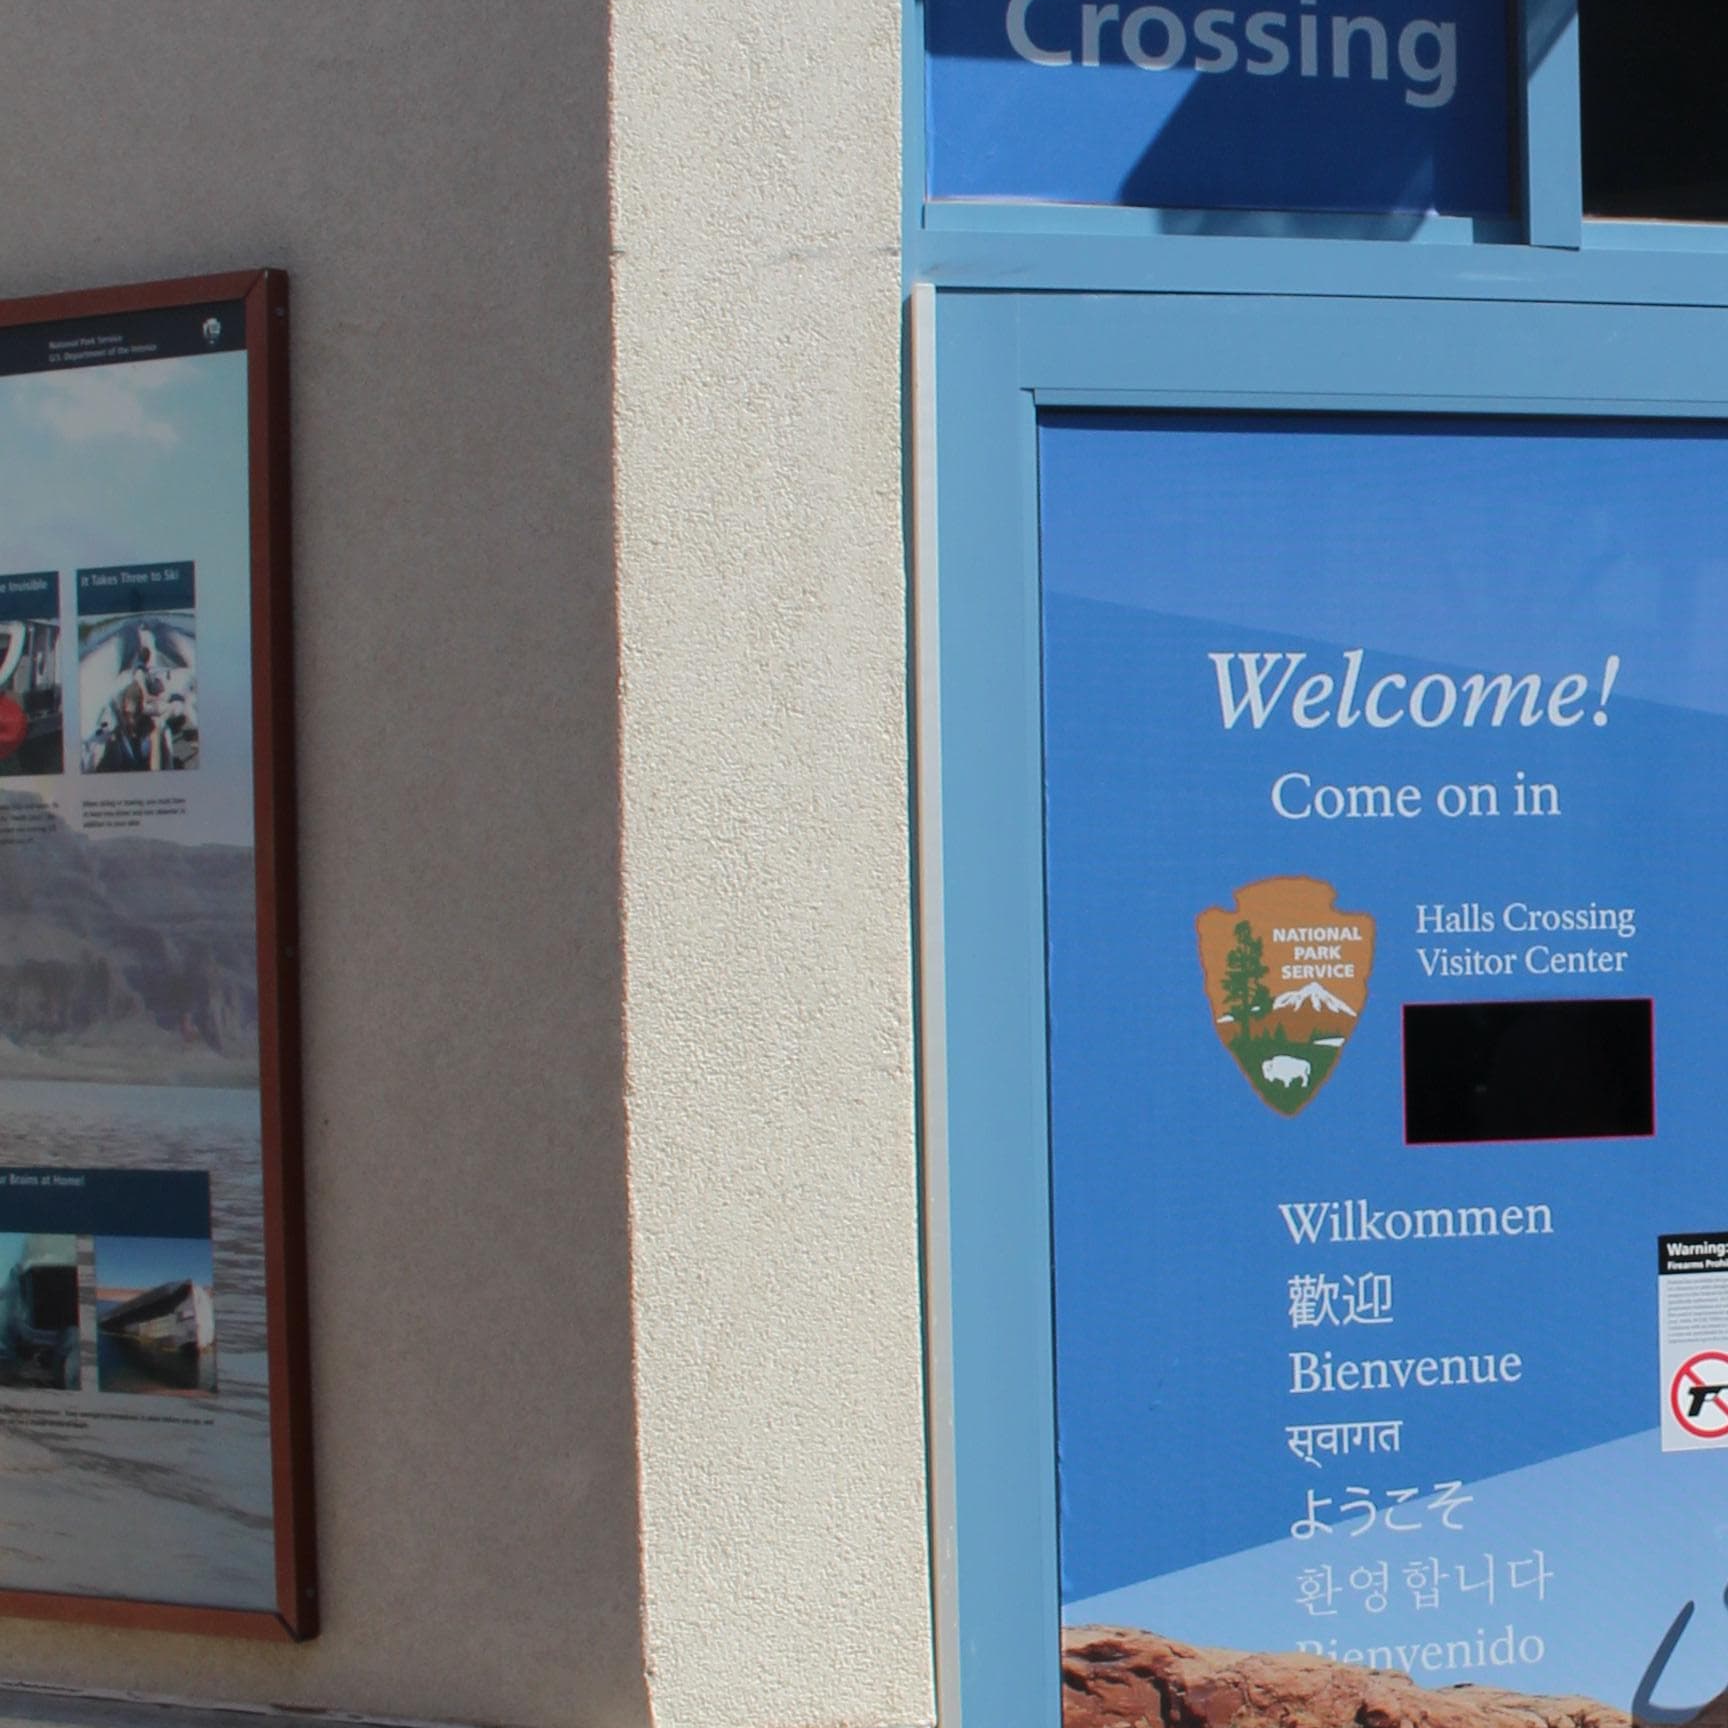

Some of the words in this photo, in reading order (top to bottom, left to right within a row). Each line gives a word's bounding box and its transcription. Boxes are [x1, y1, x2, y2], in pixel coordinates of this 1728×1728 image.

[1208, 648, 1620, 729] Welcome!
[1271, 772, 1421, 820] Come
[1436, 781, 1501, 816] on
[1513, 771, 1561, 816] in
[1272, 926, 1363, 943] NATIONAL
[1416, 903, 1495, 934] Halls
[1503, 901, 1636, 938] Crossing
[1281, 963, 1355, 980] SERVICE
[1294, 944, 1342, 961] PARK
[1418, 948, 1518, 977] Visitor
[1525, 945, 1628, 975] Center
[1279, 1200, 1554, 1245] Wilkommen
[1667, 1260, 1704, 1270] Firearms
[1288, 1271, 1394, 1329] 歡迎
[1288, 1349, 1523, 1394] Bienvenue
[1285, 1420, 1403, 1468] स्वागत
[1291, 1480, 1474, 1540] ようこそ
[1296, 1548, 1555, 1616] 환영합니다
